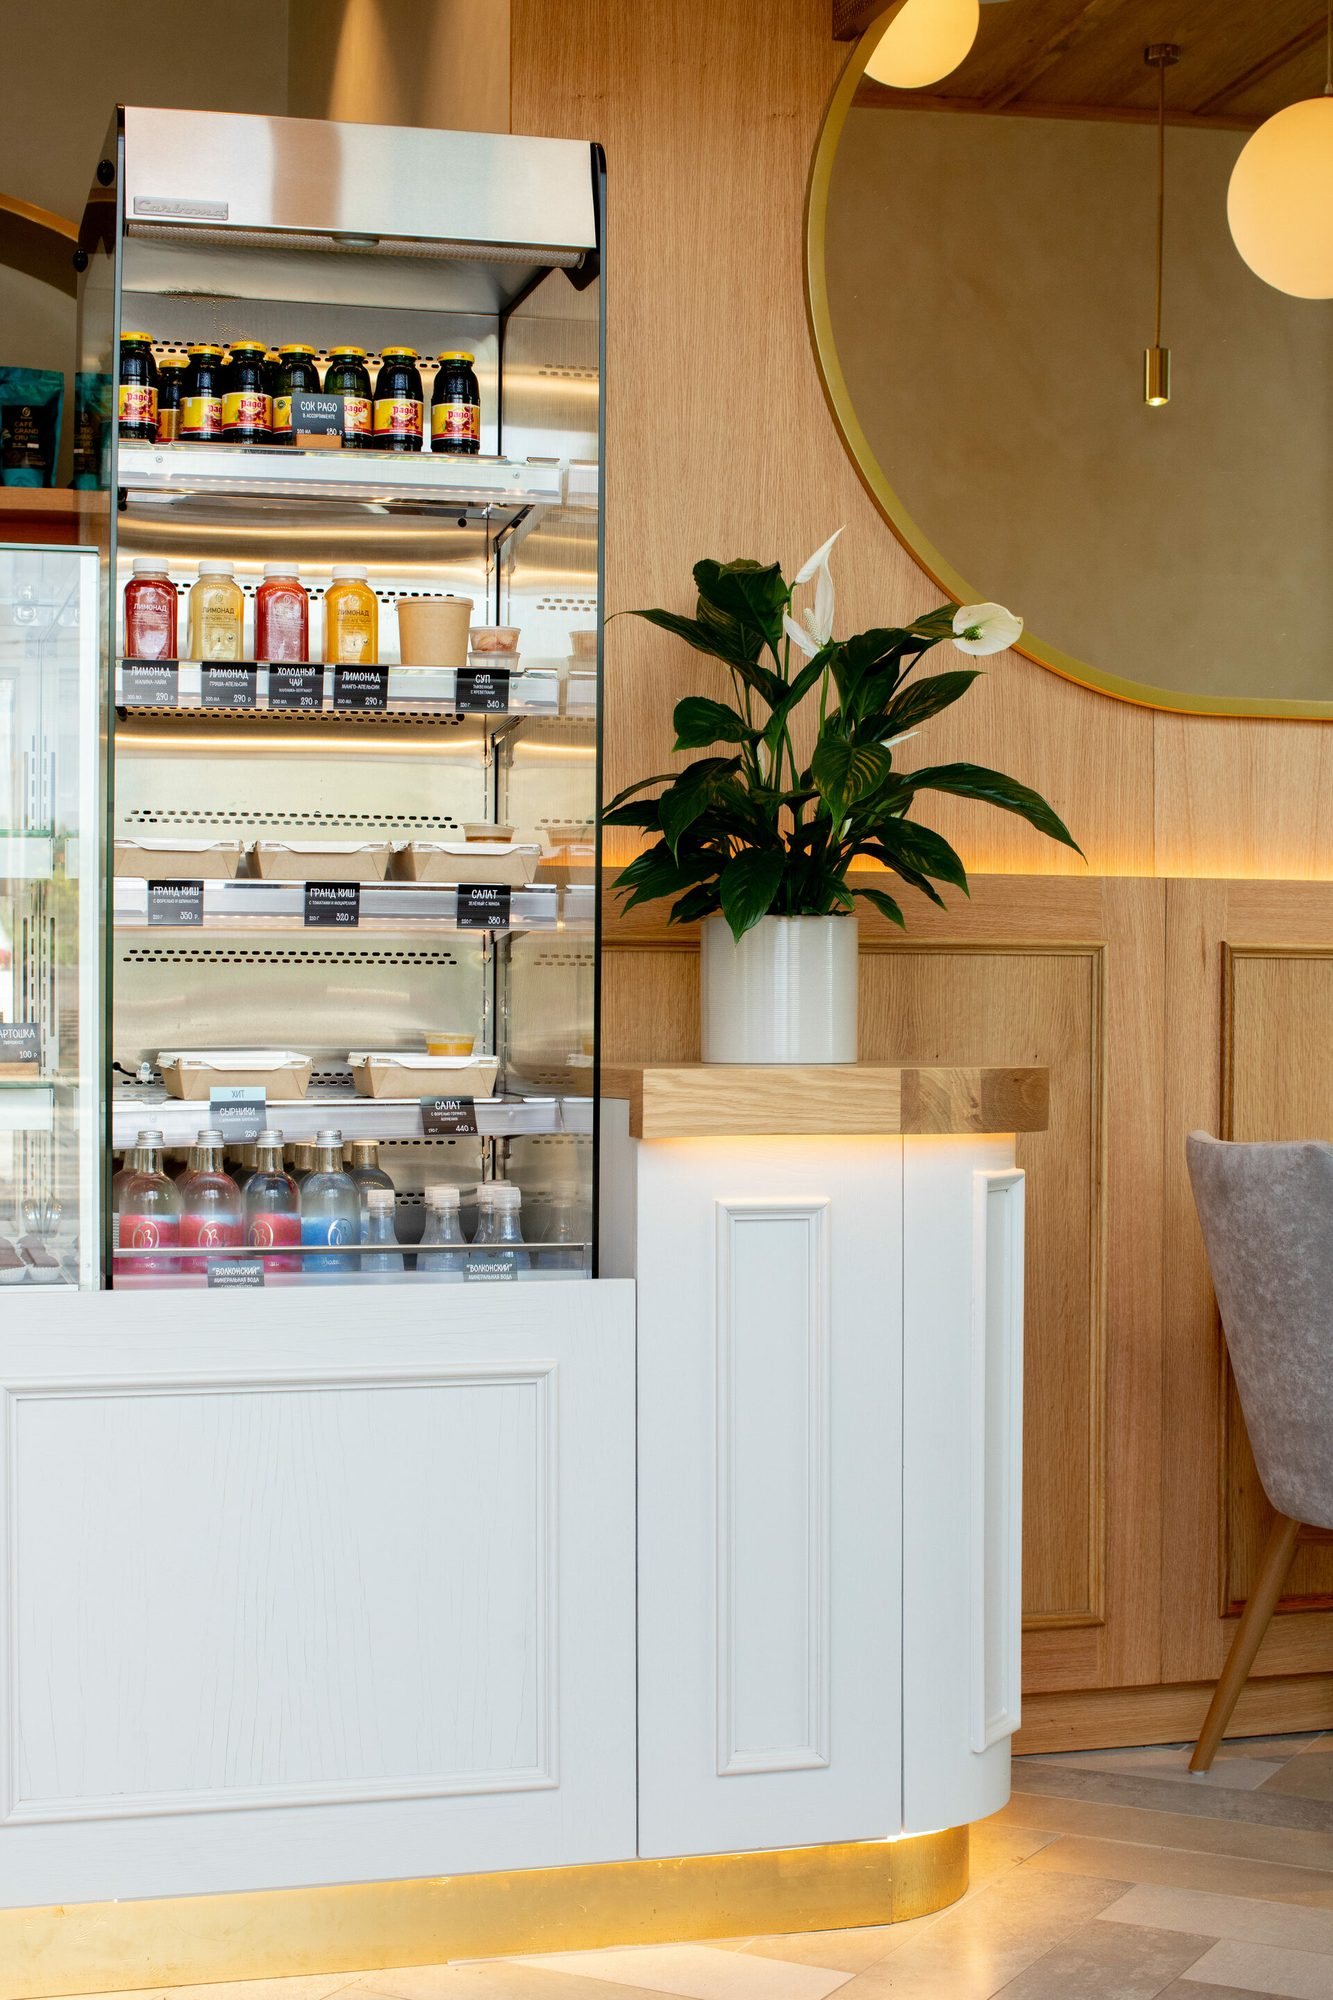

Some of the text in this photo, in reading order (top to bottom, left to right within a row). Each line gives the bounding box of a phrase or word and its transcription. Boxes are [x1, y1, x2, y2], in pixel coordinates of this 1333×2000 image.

[127, 392, 148, 403] pago
[208, 404, 222, 414] pag
[240, 399, 262, 410] pago
[301, 401, 337, 412] СОК PAGO
[393, 406, 414, 416] pago
[448, 411, 469, 421] pago
[134, 603, 167, 612] ЛИМОНАД
[131, 666, 171, 678] ЛИМОНАД
[209, 668, 249, 680] ЛИМОНАД
[277, 667, 316, 677] ХОЛОДНЫЙ
[342, 671, 381, 683] ЛИМОНАД
[475, 674, 491, 683] СУП
[289, 678, 303, 687] ЧАЙ
[156, 693, 168, 701] 290
[301, 697, 313, 705] 290
[365, 697, 377, 705] 290
[487, 700, 499, 708] 340
[154, 886, 199, 897] ГРАНД КИШ
[310, 888, 355, 898] ГРАНД КИШ
[472, 889, 498, 899] САЛАТ
[180, 912, 193, 920] 350
[336, 913, 349, 921] 320
[488, 916, 500, 925] 380
[0, 1029, 35, 1039] АРТОШКА
[20, 1051, 32, 1059] 100
[232, 1090, 245, 1098] ХИТ
[435, 1101, 461, 1110] САЛАТ
[220, 1107, 255, 1116] СЫРНИКИ
